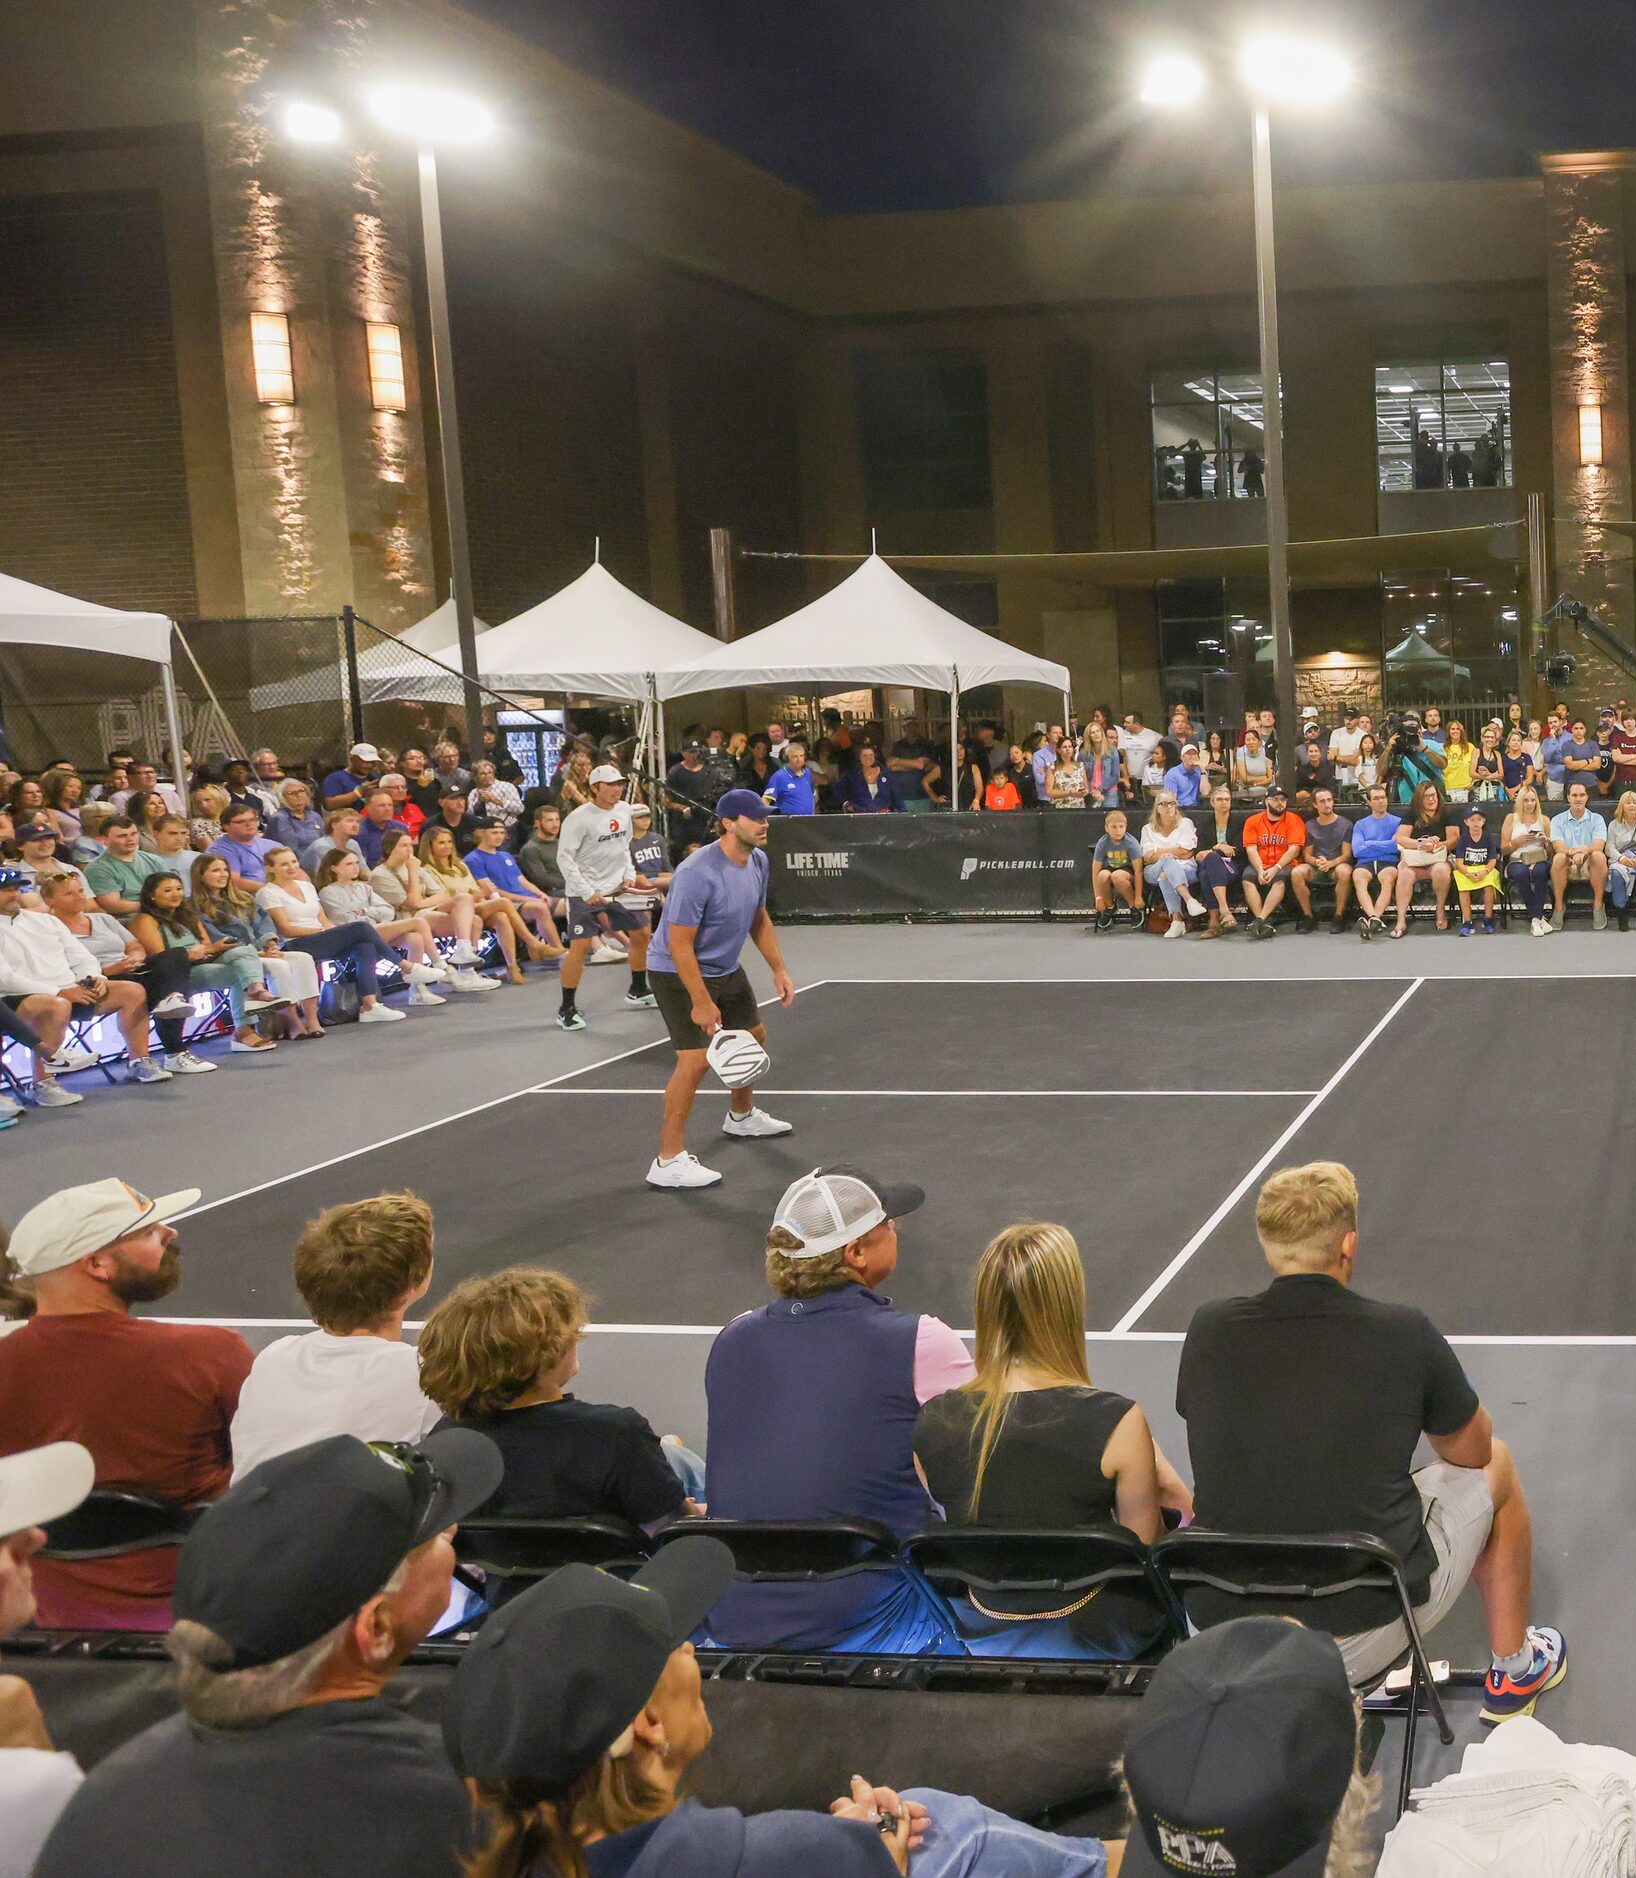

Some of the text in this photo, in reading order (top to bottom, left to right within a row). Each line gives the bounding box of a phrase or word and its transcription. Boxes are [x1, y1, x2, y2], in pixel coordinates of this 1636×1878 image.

[635, 847, 662, 864] SMU
[786, 852, 849, 869] LIFE TIME
[824, 869, 842, 877] TEXAS
[979, 860, 1075, 870] PICKLEBALL.COM
[1158, 1826, 1235, 1863] PPA
